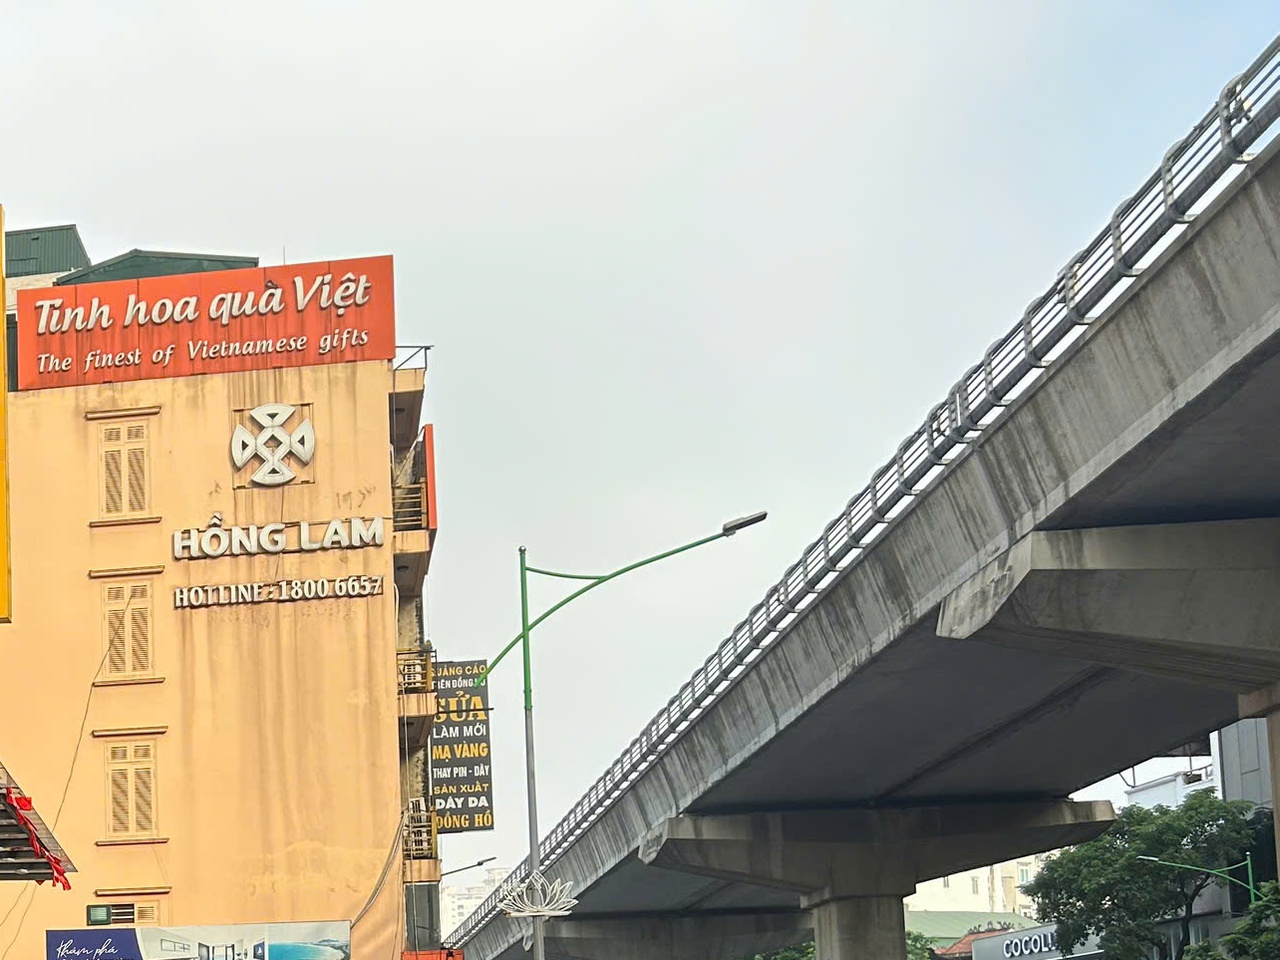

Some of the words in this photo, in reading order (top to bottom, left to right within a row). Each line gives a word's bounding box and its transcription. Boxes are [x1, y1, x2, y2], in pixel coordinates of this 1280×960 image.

[123, 294, 198, 327] hoa
[209, 280, 285, 325] quà
[293, 272, 372, 316] Việt
[37, 353, 72, 374] The
[84, 347, 141, 372] finest
[152, 344, 175, 367] of
[188, 333, 307, 360] Vietnamese
[319, 328, 368, 353] gifts
[172, 512, 287, 560] HỒNG
[299, 517, 385, 551] LAM
[279, 578, 329, 600] 1800
[335, 576, 383, 596] 6657
[465, 663, 486, 675] CÁO
[434, 690, 487, 723] SỬA
[433, 725, 459, 738] LÀM
[463, 722, 486, 737] MỚI
[432, 745, 452, 763] MẠ
[453, 741, 488, 758] VÀNG
[433, 767, 451, 778] THAY
[453, 766, 467, 778] PIN
[474, 762, 489, 776] DÂY
[435, 796, 465, 810] DÂY
[468, 796, 489, 808] DA
[474, 809, 492, 827] HỒ
[93, 938, 118, 960] phá
[1004, 932, 1057, 958] COCOLU
